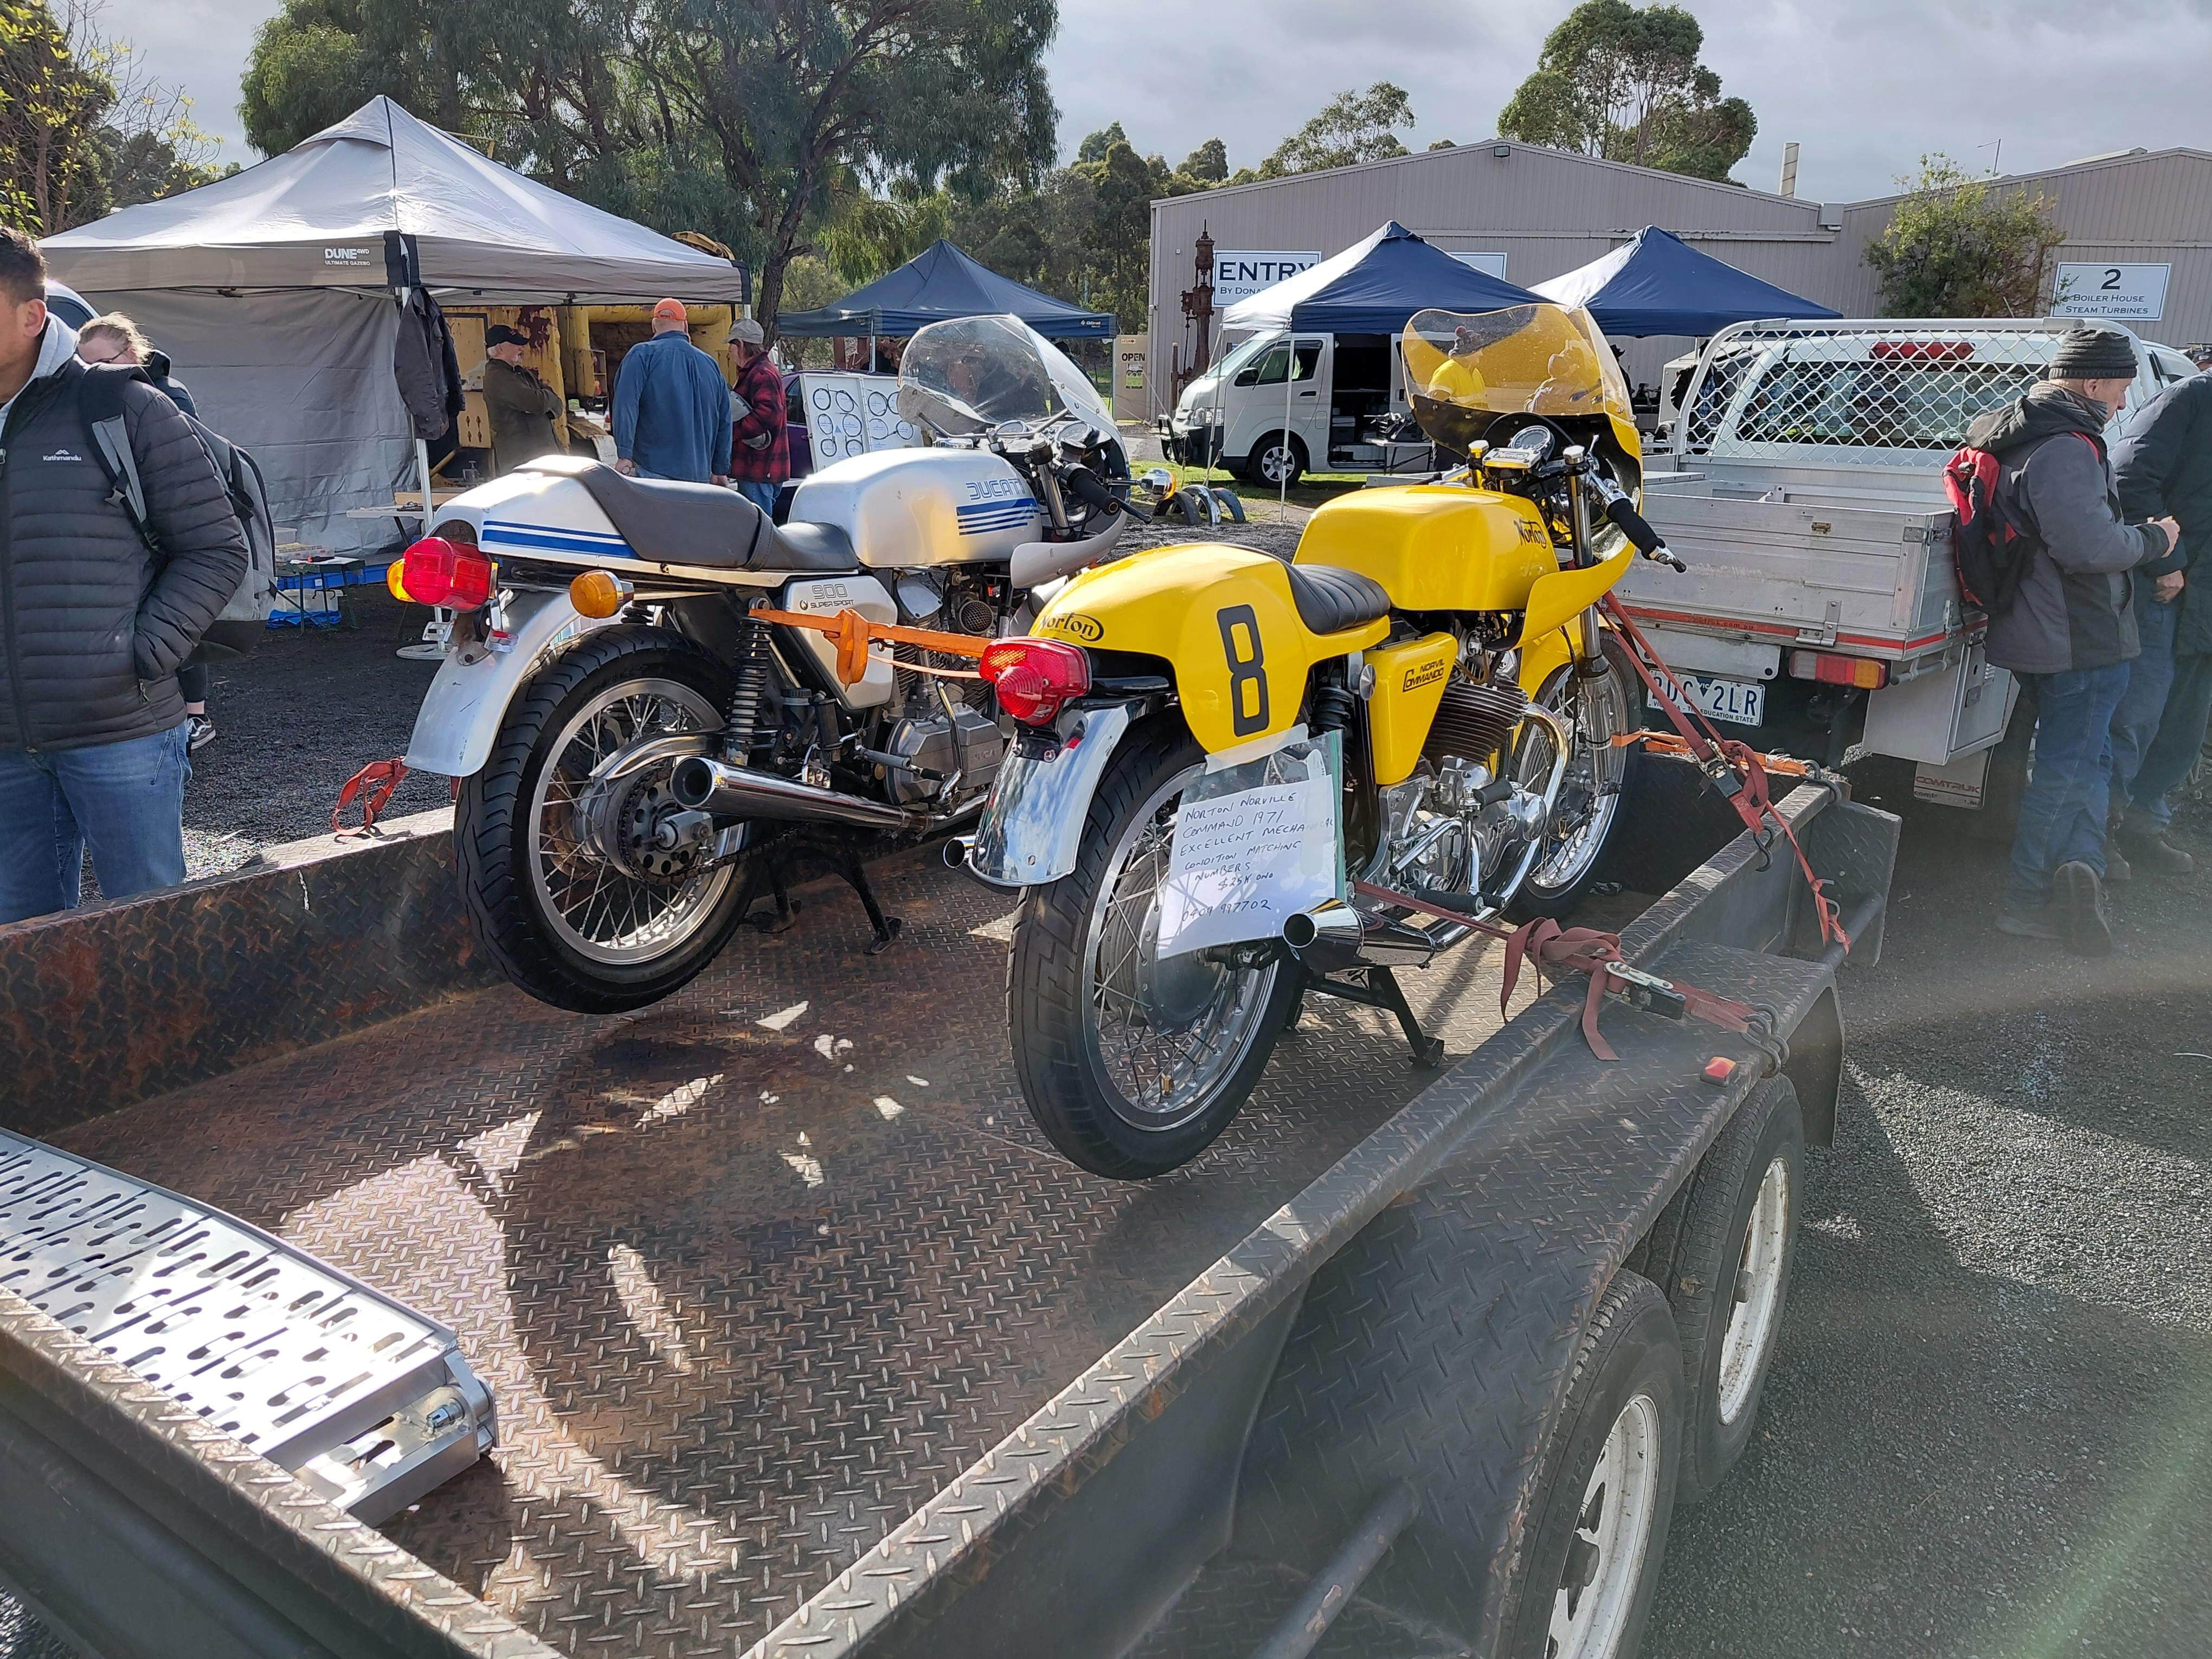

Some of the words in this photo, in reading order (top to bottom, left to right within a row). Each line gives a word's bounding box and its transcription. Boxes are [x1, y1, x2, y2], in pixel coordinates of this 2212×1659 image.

[325, 248, 357, 259] DUNE
[2100, 269, 2121, 291] 2
[1121, 353, 1146, 362] OPEN
[966, 478, 1026, 500] DUCATI
[1513, 519, 1547, 549] Norton
[812, 583, 848, 600] 900
[833, 599, 854, 607] SPORT
[1217, 603, 1269, 738] 8
[1713, 685, 1758, 716] 2LR
[1700, 709, 1733, 721] EDUCATION
[1735, 715, 1754, 723] STATE
[1915, 776, 1980, 794] COMTRUK
[1185, 802, 1234, 822] NORTON
[1240, 793, 1297, 807] NORVILLE
[1253, 809, 1284, 825] 1971
[1180, 831, 1254, 857] EXCELLENT
[1185, 853, 1237, 870] CONDITION
[1218, 874, 1252, 891] $25K
[1220, 899, 1271, 914] 997702
